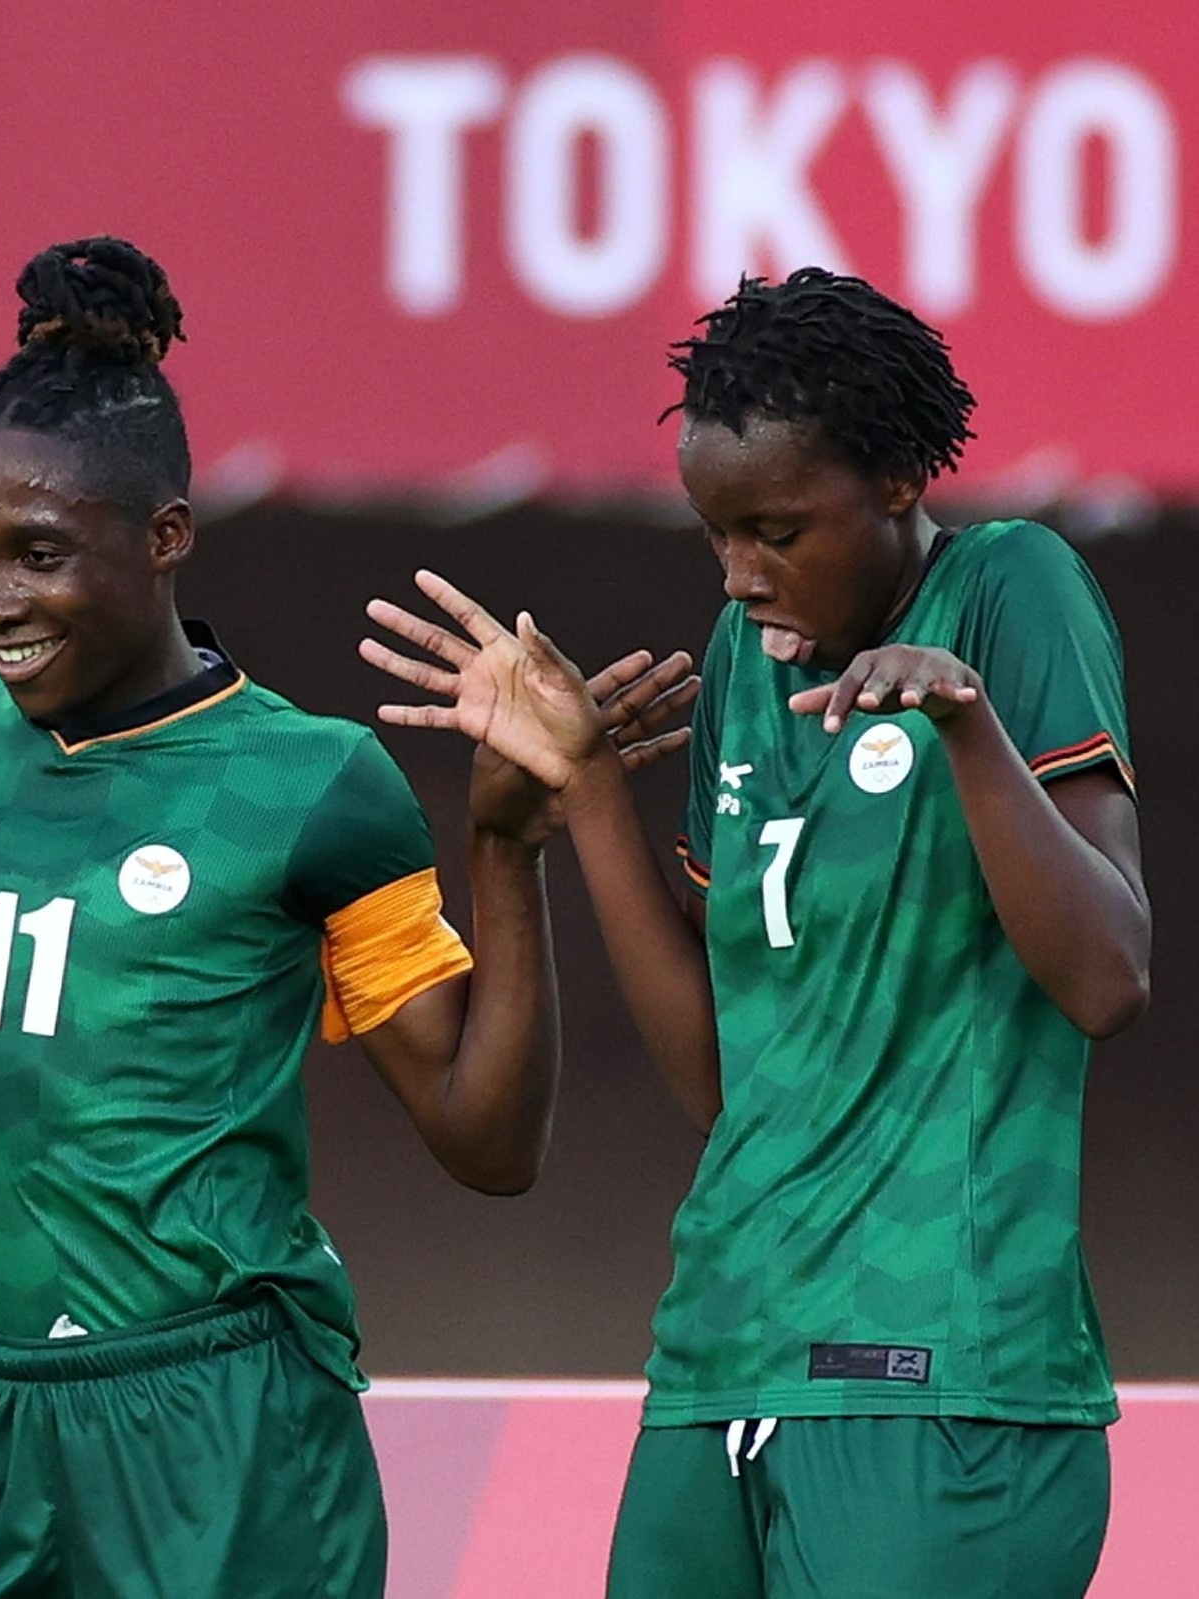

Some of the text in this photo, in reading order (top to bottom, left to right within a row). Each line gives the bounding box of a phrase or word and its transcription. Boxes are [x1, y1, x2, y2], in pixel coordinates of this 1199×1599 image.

[345, 56, 1177, 318] TOKYO
[862, 760, 899, 770] ZAMBIA
[759, 817, 805, 948] 7
